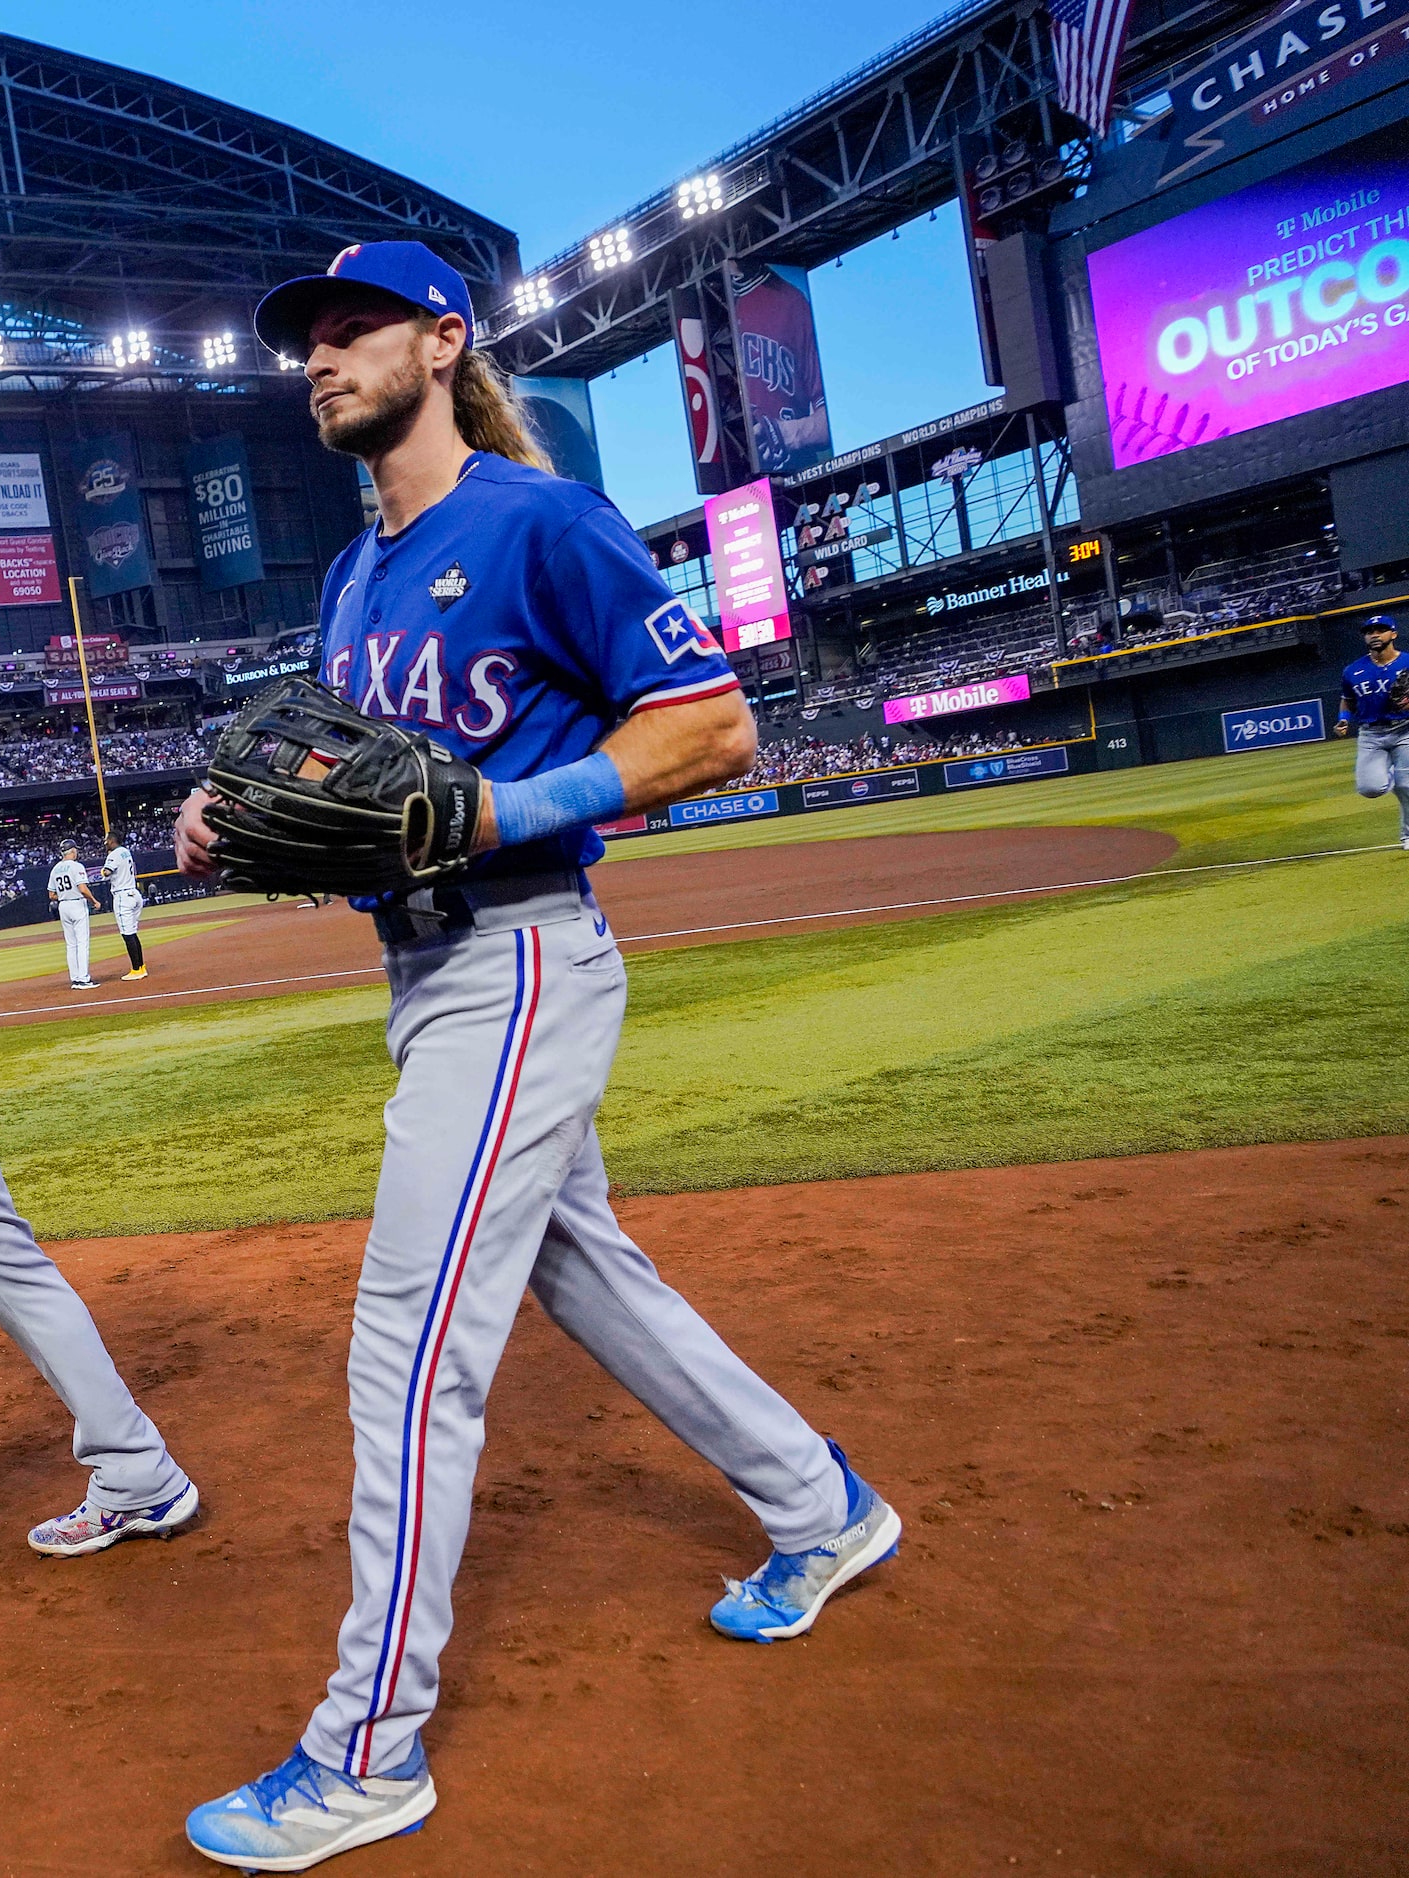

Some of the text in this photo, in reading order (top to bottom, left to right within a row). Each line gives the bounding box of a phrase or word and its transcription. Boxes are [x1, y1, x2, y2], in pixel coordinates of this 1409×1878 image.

[1192, 0, 1387, 113] CHASE
[1262, 42, 1381, 116] HOME OF
[1301, 189, 1381, 232] Mobile
[1247, 225, 1361, 288] PREDICT
[1157, 238, 1409, 375] OUTCO
[1226, 303, 1409, 381] OF TODAY'S G
[902, 399, 1003, 444] WORLD CHAMPIONS
[192, 463, 240, 484] CELEBRATING
[797, 464, 823, 483] WEST
[825, 443, 882, 472] CHAMPIONS
[92, 466, 114, 489] 25
[33, 484, 42, 498] IT
[194, 474, 244, 507] $80
[198, 500, 247, 525] MILLION
[219, 519, 229, 530] IN
[201, 523, 250, 544] CHARITABLE
[203, 534, 252, 560] GIVING
[814, 535, 868, 561] WILD CARD
[1068, 539, 1100, 563] 3:04
[2, 568, 46, 579] LOCATION
[434, 577, 468, 588] WORLD
[13, 586, 42, 596] 69050
[431, 586, 465, 598] SERIES
[945, 568, 1071, 611] Banner Heal
[49, 648, 127, 662] SANDLOT
[225, 660, 310, 685] BOURBON & BONES
[61, 686, 128, 701] ALL-YOUAN-EAT SEATS
[326, 630, 520, 743] EXAS
[930, 684, 999, 715] Mobile
[1107, 738, 1128, 750] 413
[806, 790, 830, 799] PEPSI
[891, 778, 915, 787] PEPSI
[446, 788, 466, 851] Wilson
[681, 797, 745, 821] CHASE
[649, 819, 669, 830] 374
[55, 874, 73, 893] 39
